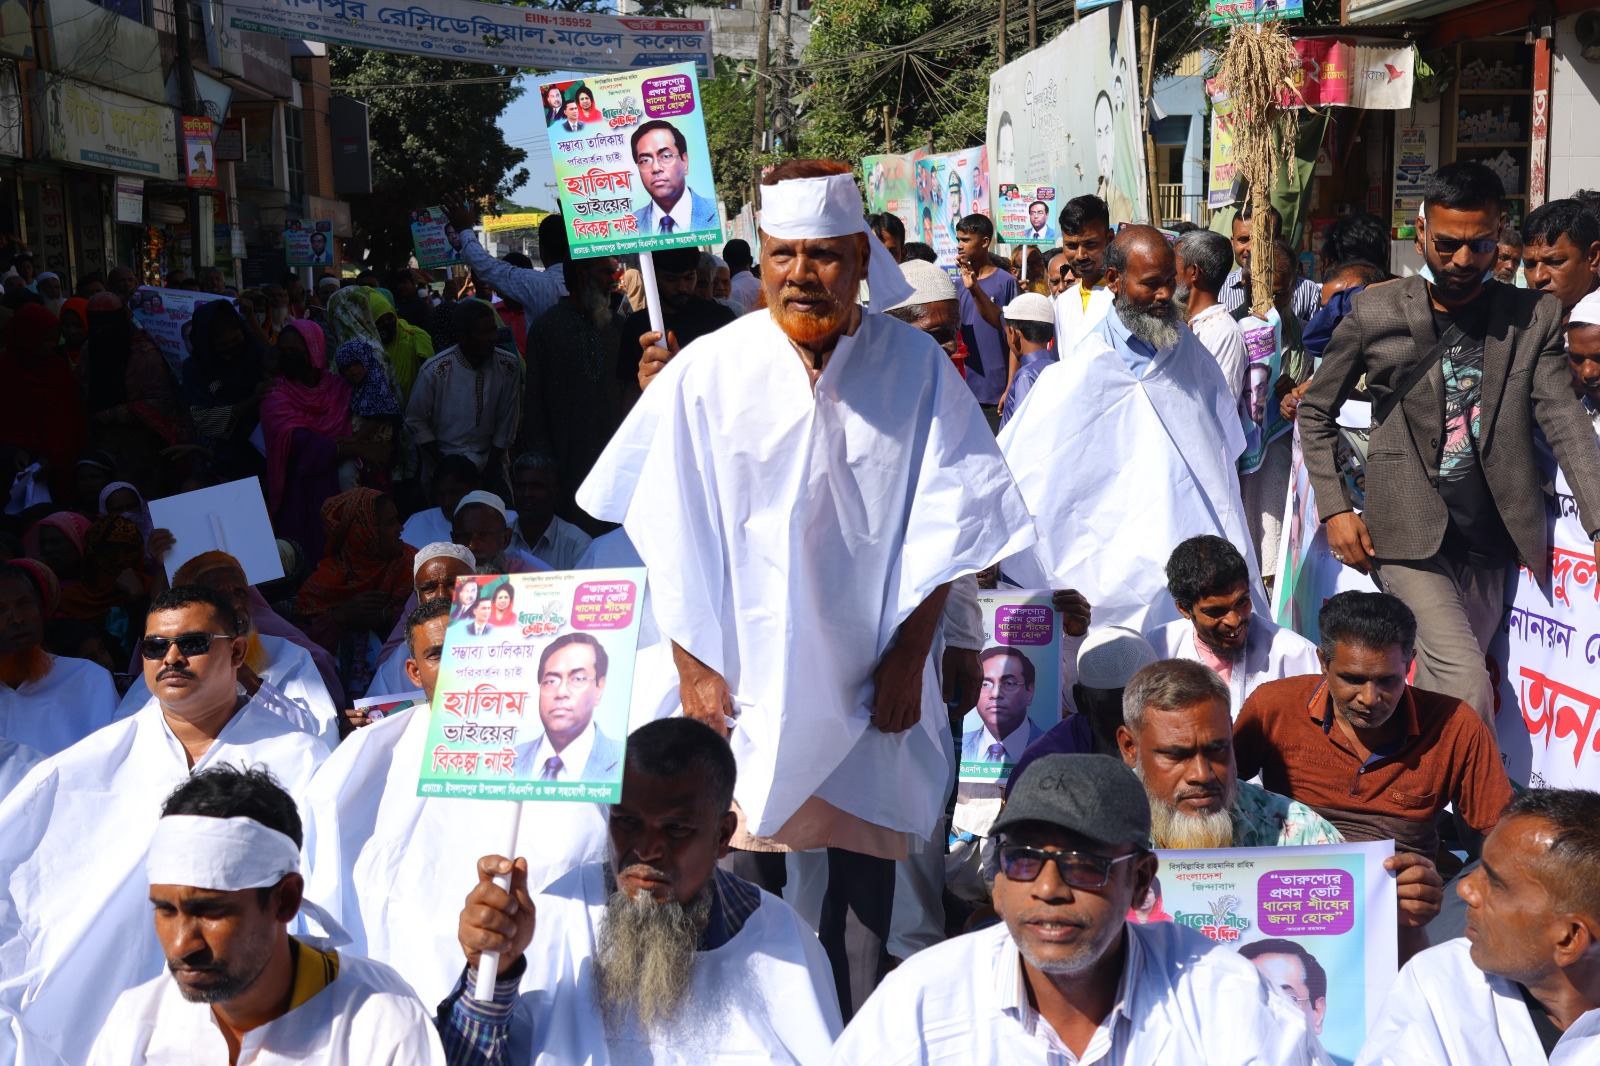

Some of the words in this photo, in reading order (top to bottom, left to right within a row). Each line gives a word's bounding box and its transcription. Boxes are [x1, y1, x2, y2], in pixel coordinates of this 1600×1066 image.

[525, 12, 592, 28] EIIN-135952
[627, 20, 657, 30] ভর্তি
[377, 6, 547, 44] রেসিডেন্সিয়াল
[554, 29, 624, 49] মডেল
[630, 34, 704, 49] কলেজ
[1321, 70, 1348, 80] এজেন্ট
[1362, 67, 1385, 81] বিকাশ
[648, 88, 667, 97] প্রথম
[669, 84, 686, 93] ভোট
[646, 96, 667, 105] ধানের
[602, 107, 623, 118] ধানের
[649, 104, 665, 112] জন্য
[183, 118, 211, 131] কণিকা
[625, 115, 637, 125] দিন
[557, 140, 583, 152] সম্ভাব্য
[586, 133, 625, 149] তালিকায়
[567, 154, 603, 166] পরিবর্তন
[605, 151, 622, 162] চাই
[563, 167, 632, 196] হালিম
[573, 198, 631, 214] ভাইয়ের
[573, 218, 609, 238] বিকল্প
[612, 215, 638, 233] নাই
[638, 239, 658, 248] বিএনপি
[583, 583, 631, 593] “তারুণ্যের
[581, 594, 604, 603] প্রথম
[606, 591, 628, 602] ভোট
[575, 603, 602, 613] ধানের
[1003, 606, 1047, 616] “তারুণ্যের
[518, 611, 544, 624] ধানের
[577, 613, 597, 622] জন্য
[1002, 615, 1023, 623] প্রথম
[1026, 613, 1046, 624] ভোট
[544, 622, 557, 632] দিন
[997, 623, 1022, 631] ধানের
[1000, 631, 1018, 639] জন্য
[451, 645, 482, 660] সম্ভাব্য
[488, 641, 535, 660] তালিকায়
[455, 666, 500, 678] পরিবর্তন
[504, 666, 523, 678] চাই
[443, 684, 529, 717] হালিম
[443, 722, 517, 743] ভাইয়ের
[432, 745, 480, 773] বিকল্প
[484, 747, 516, 773] নাই
[508, 783, 534, 795] বিএনপি
[536, 786, 542, 795] ও
[1206, 861, 1235, 869] রাহমানির
[1236, 860, 1255, 869] রাহিম
[1176, 872, 1223, 881] বাংলাদেশ
[1270, 874, 1343, 886] “তারুণ্যের
[1192, 882, 1236, 892] জিন্দাবাদ
[1269, 887, 1305, 899] প্রথম
[1309, 884, 1342, 898] ভোট
[1263, 900, 1303, 912] ধানের
[1306, 897, 1351, 911] শীষের
[1223, 911, 1248, 929] শীষে
[1266, 914, 1298, 925] জন্য
[1301, 911, 1343, 925] হোক”
[1217, 925, 1239, 942] দিন
